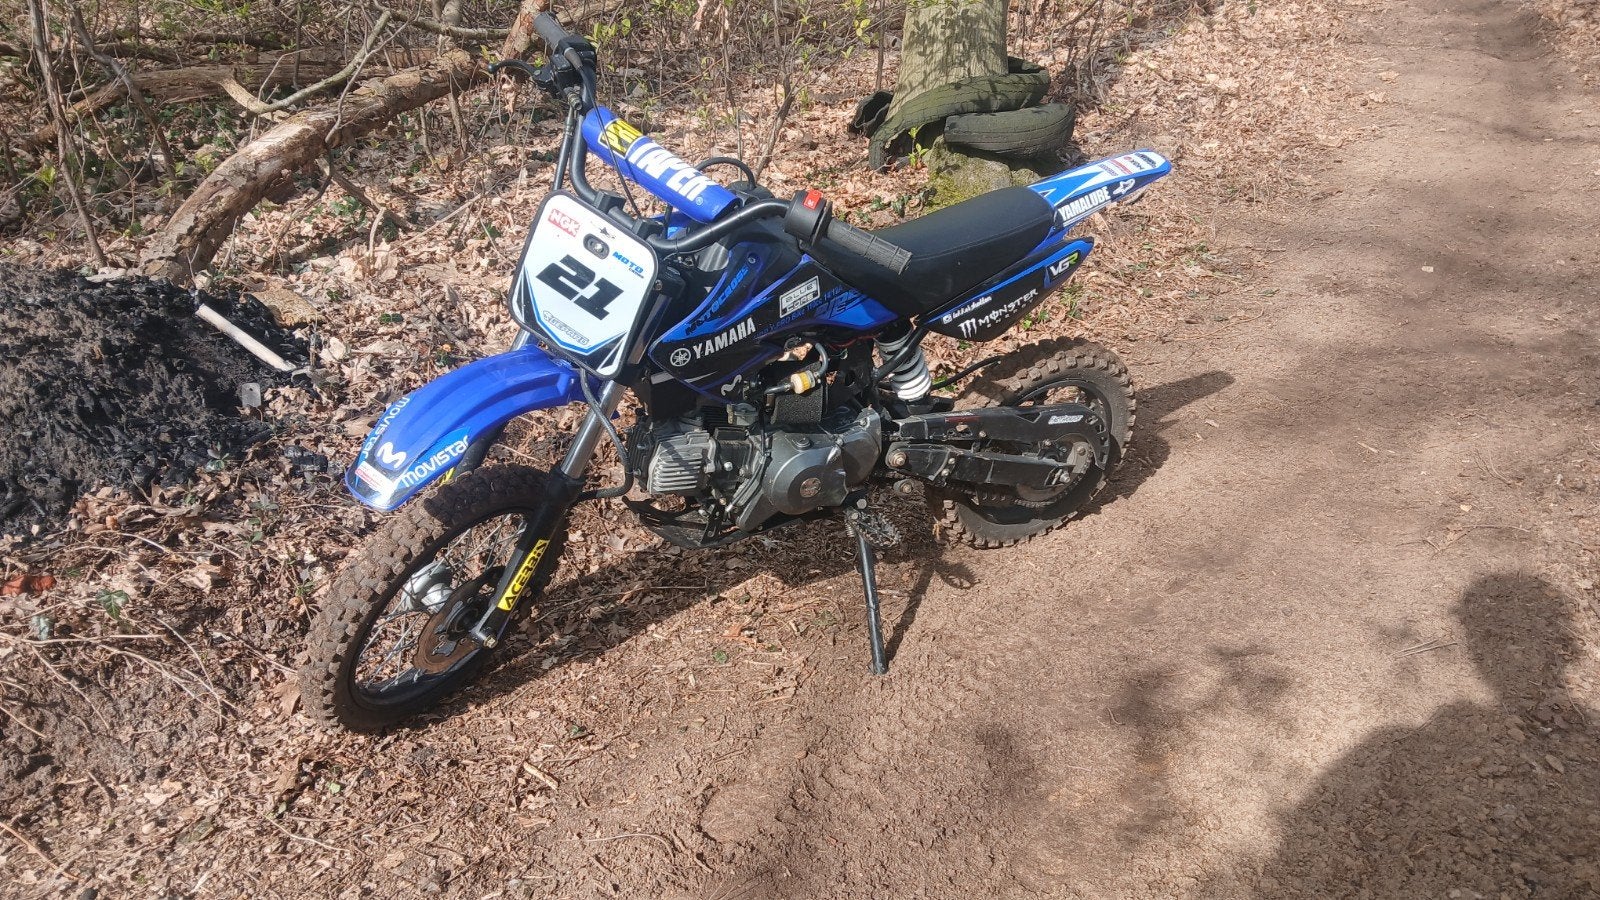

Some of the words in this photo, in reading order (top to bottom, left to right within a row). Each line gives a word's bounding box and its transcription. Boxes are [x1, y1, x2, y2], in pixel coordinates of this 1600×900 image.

[628, 142, 719, 202] TAPER
[549, 208, 581, 237] NGK
[1058, 186, 1111, 221] YAMALUBE
[612, 251, 644, 273] MOTO
[1050, 252, 1078, 276] VGR
[536, 253, 624, 320] 21
[685, 266, 749, 336] MOTOCROSS
[785, 282, 813, 303] BLUE
[786, 292, 814, 312] CORE
[978, 288, 1038, 326] MONSTER
[693, 317, 756, 359] YAMAHA
[360, 396, 410, 460] movistar
[400, 435, 469, 488] movistar
[505, 541, 548, 609] ACERBIS
